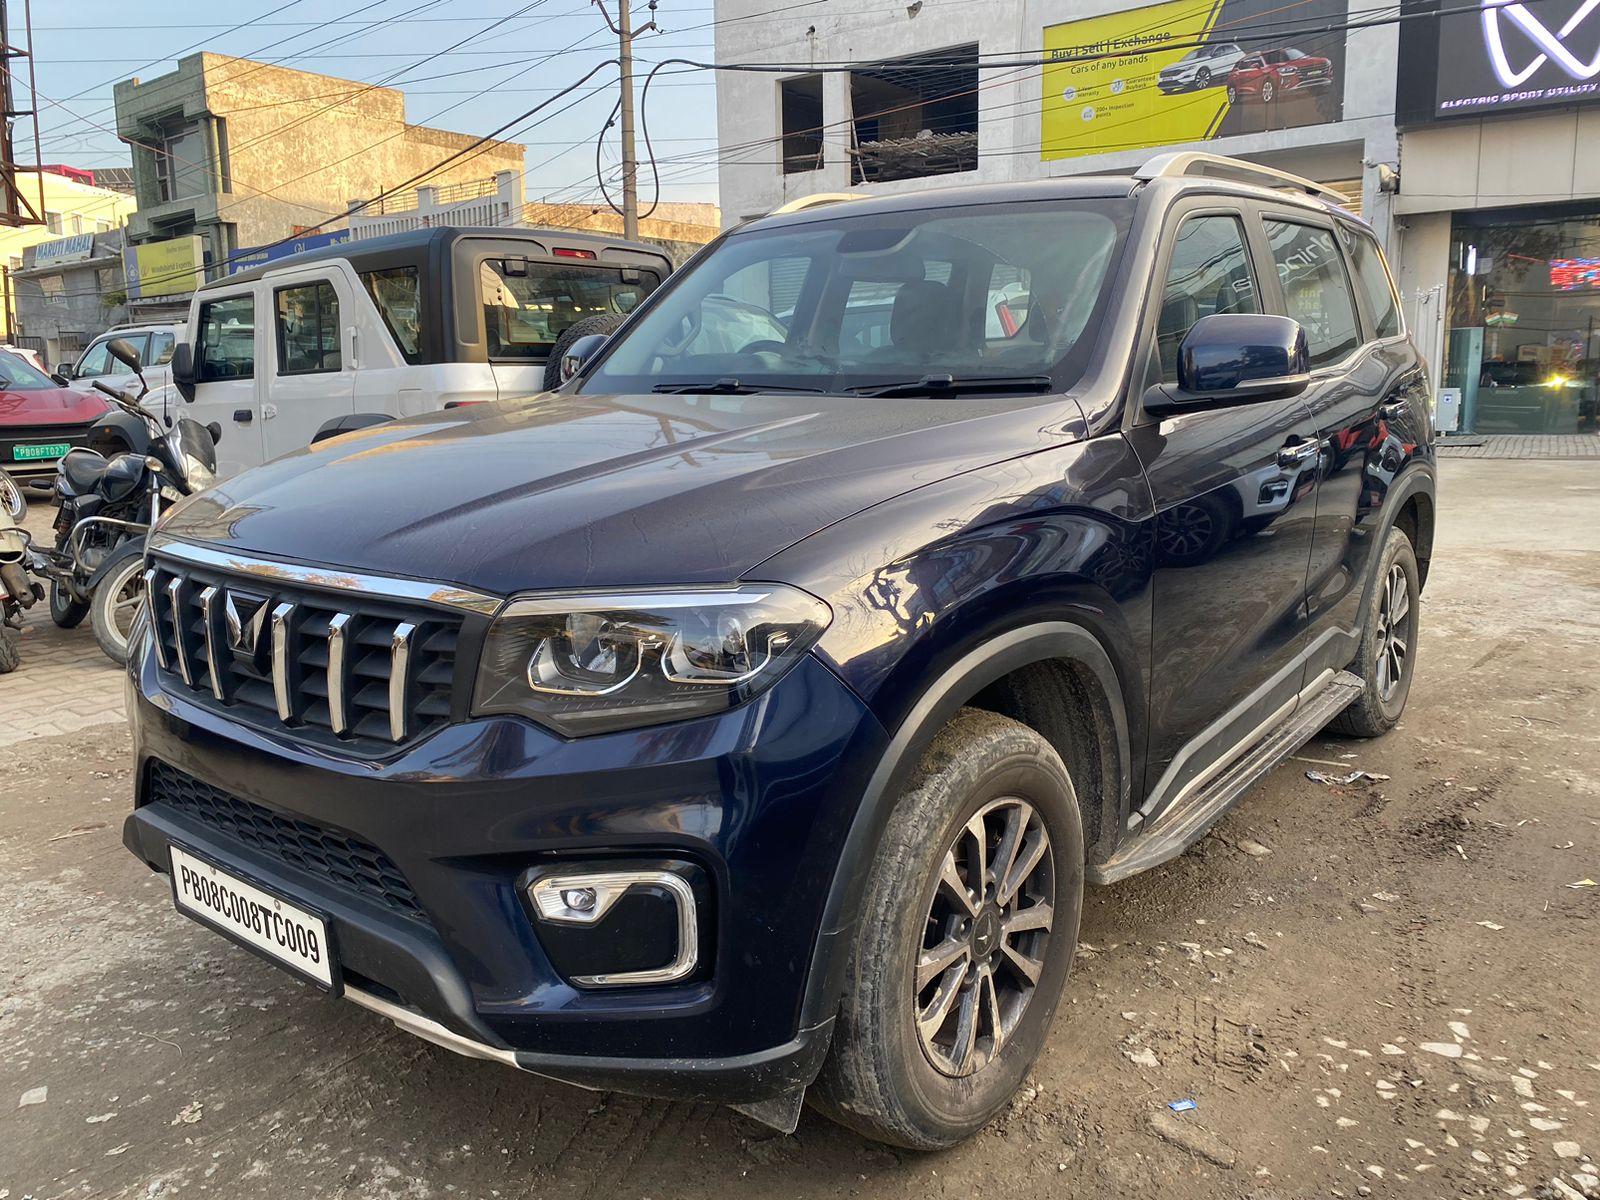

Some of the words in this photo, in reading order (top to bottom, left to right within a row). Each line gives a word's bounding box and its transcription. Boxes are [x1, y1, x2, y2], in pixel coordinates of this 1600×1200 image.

[1051, 49, 1072, 60] Buy
[1082, 42, 1104, 55] Sell
[1113, 31, 1171, 49] Exchange
[1070, 66, 1089, 75] Cars
[1091, 62, 1101, 71] of
[1101, 61, 1117, 70] any
[1119, 55, 1149, 67] brands
[1440, 95, 1499, 109] ELECTRIC
[1500, 89, 1545, 102] SPORT
[1547, 83, 1599, 96] UTILITY
[37, 241, 64, 259] MARUTI
[65, 232, 91, 254] MAHAL
[181, 864, 320, 964] PB08C008TC009
